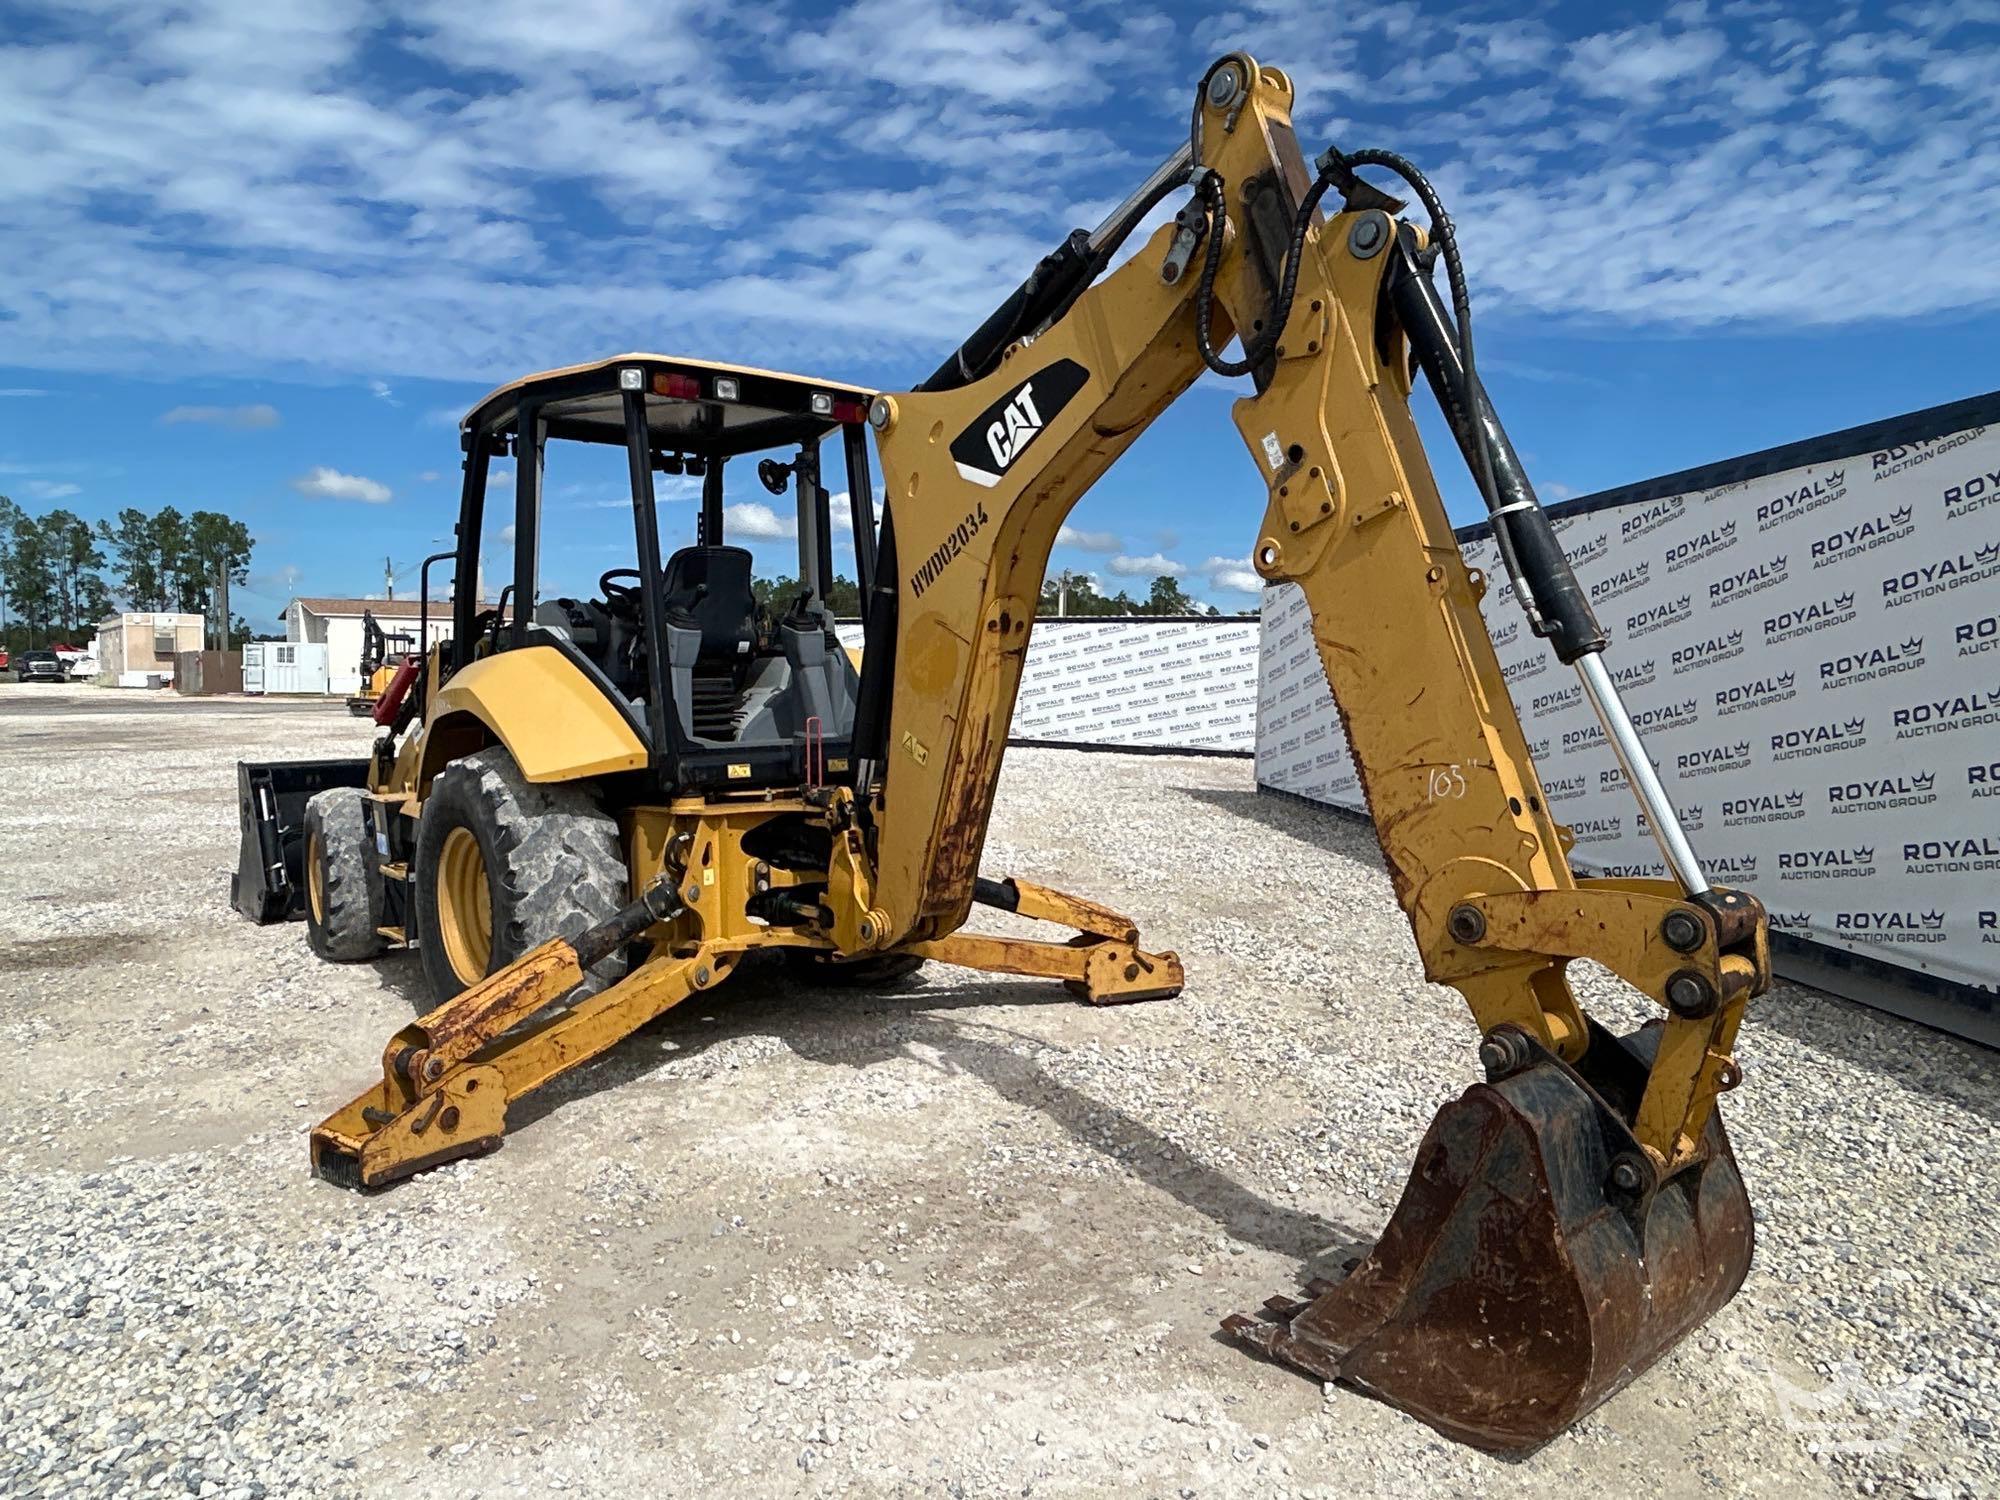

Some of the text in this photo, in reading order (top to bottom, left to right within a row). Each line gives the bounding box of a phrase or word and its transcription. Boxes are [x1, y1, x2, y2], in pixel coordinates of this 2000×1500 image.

[986, 382, 1043, 468] CAT
[1874, 426, 1986, 482] AUCTION GROUP
[1757, 481, 1826, 522] ROYAL
[1944, 471, 2000, 507] ROY
[1621, 502, 1670, 535] ROYAL
[1758, 488, 1847, 534] AUCTION GROUP
[1947, 492, 2000, 520] AUCTIO
[1622, 507, 1686, 544] AUCTION GROUP
[1811, 517, 1890, 558] ROYAL
[910, 502, 989, 599] HWD02034
[1564, 542, 1596, 565] OYAL
[1665, 530, 1721, 564] ROYAL
[1667, 537, 1738, 574] AUCTION GROUP
[1813, 525, 1915, 570] AUCTION GROUP
[1591, 568, 1637, 598] ROYAL
[1709, 565, 1770, 598] ROYAL
[1882, 555, 1975, 597] ROYAL
[1884, 564, 2000, 610] AUCTION GROUP
[1710, 573, 1789, 609] AUCTION GROUP
[1627, 602, 1677, 631] ROYAL
[1628, 610, 1692, 640] AUCTION GROUP
[1763, 601, 1834, 635] ROYAL
[1765, 611, 1857, 647] AUCTION GROUP
[1490, 627, 1509, 641] YAL
[1957, 638, 2000, 657] AUCT
[1672, 637, 1728, 665] ROYAL
[1673, 646, 1744, 675] AUCTION GROUP
[1820, 645, 1901, 679] ROYAL
[1501, 658, 1536, 678] ROYAL
[1609, 665, 1642, 684] YAL
[1821, 657, 1926, 691] AUCTION GROUP
[1533, 689, 1571, 710] ROYAL
[1716, 679, 1777, 706] ROYAL
[1717, 689, 1796, 717] AUCTION GROUP
[1632, 704, 1683, 727] ROYAL
[1893, 694, 1987, 727] ROYAL
[1562, 725, 1604, 746] ROYAL
[1638, 715, 1698, 737] UCTION GROUP
[1771, 724, 1844, 751] ROYAL
[1895, 712, 2000, 740] AUCTION GRO
[1678, 746, 1733, 769] ROYAL
[1772, 738, 1866, 762] AUCTION GROUP
[1600, 768, 1626, 784] ROY
[1679, 758, 1751, 779] AUCTION GROUP
[1544, 778, 1574, 794] OYAL
[1600, 781, 1630, 793] AUCTIO
[1829, 777, 1911, 802] ROYAL
[1722, 794, 1784, 816] ROYAL
[1831, 793, 1937, 815] AUCTION GROUP
[1724, 809, 1805, 827] AUCTION GROUP
[1575, 831, 1622, 844] CTION GROUP
[1904, 838, 2000, 861] ROYAL
[1700, 858, 1740, 873] YAL
[1779, 849, 1852, 868] ROYAL
[1906, 861, 1970, 874] AUCTION
[1724, 873, 1758, 884] GROUP
[1780, 867, 1876, 881] AUCTION GROUP
[1836, 912, 1919, 929] ROYAL
[1897, 932, 1947, 943] GROUP
